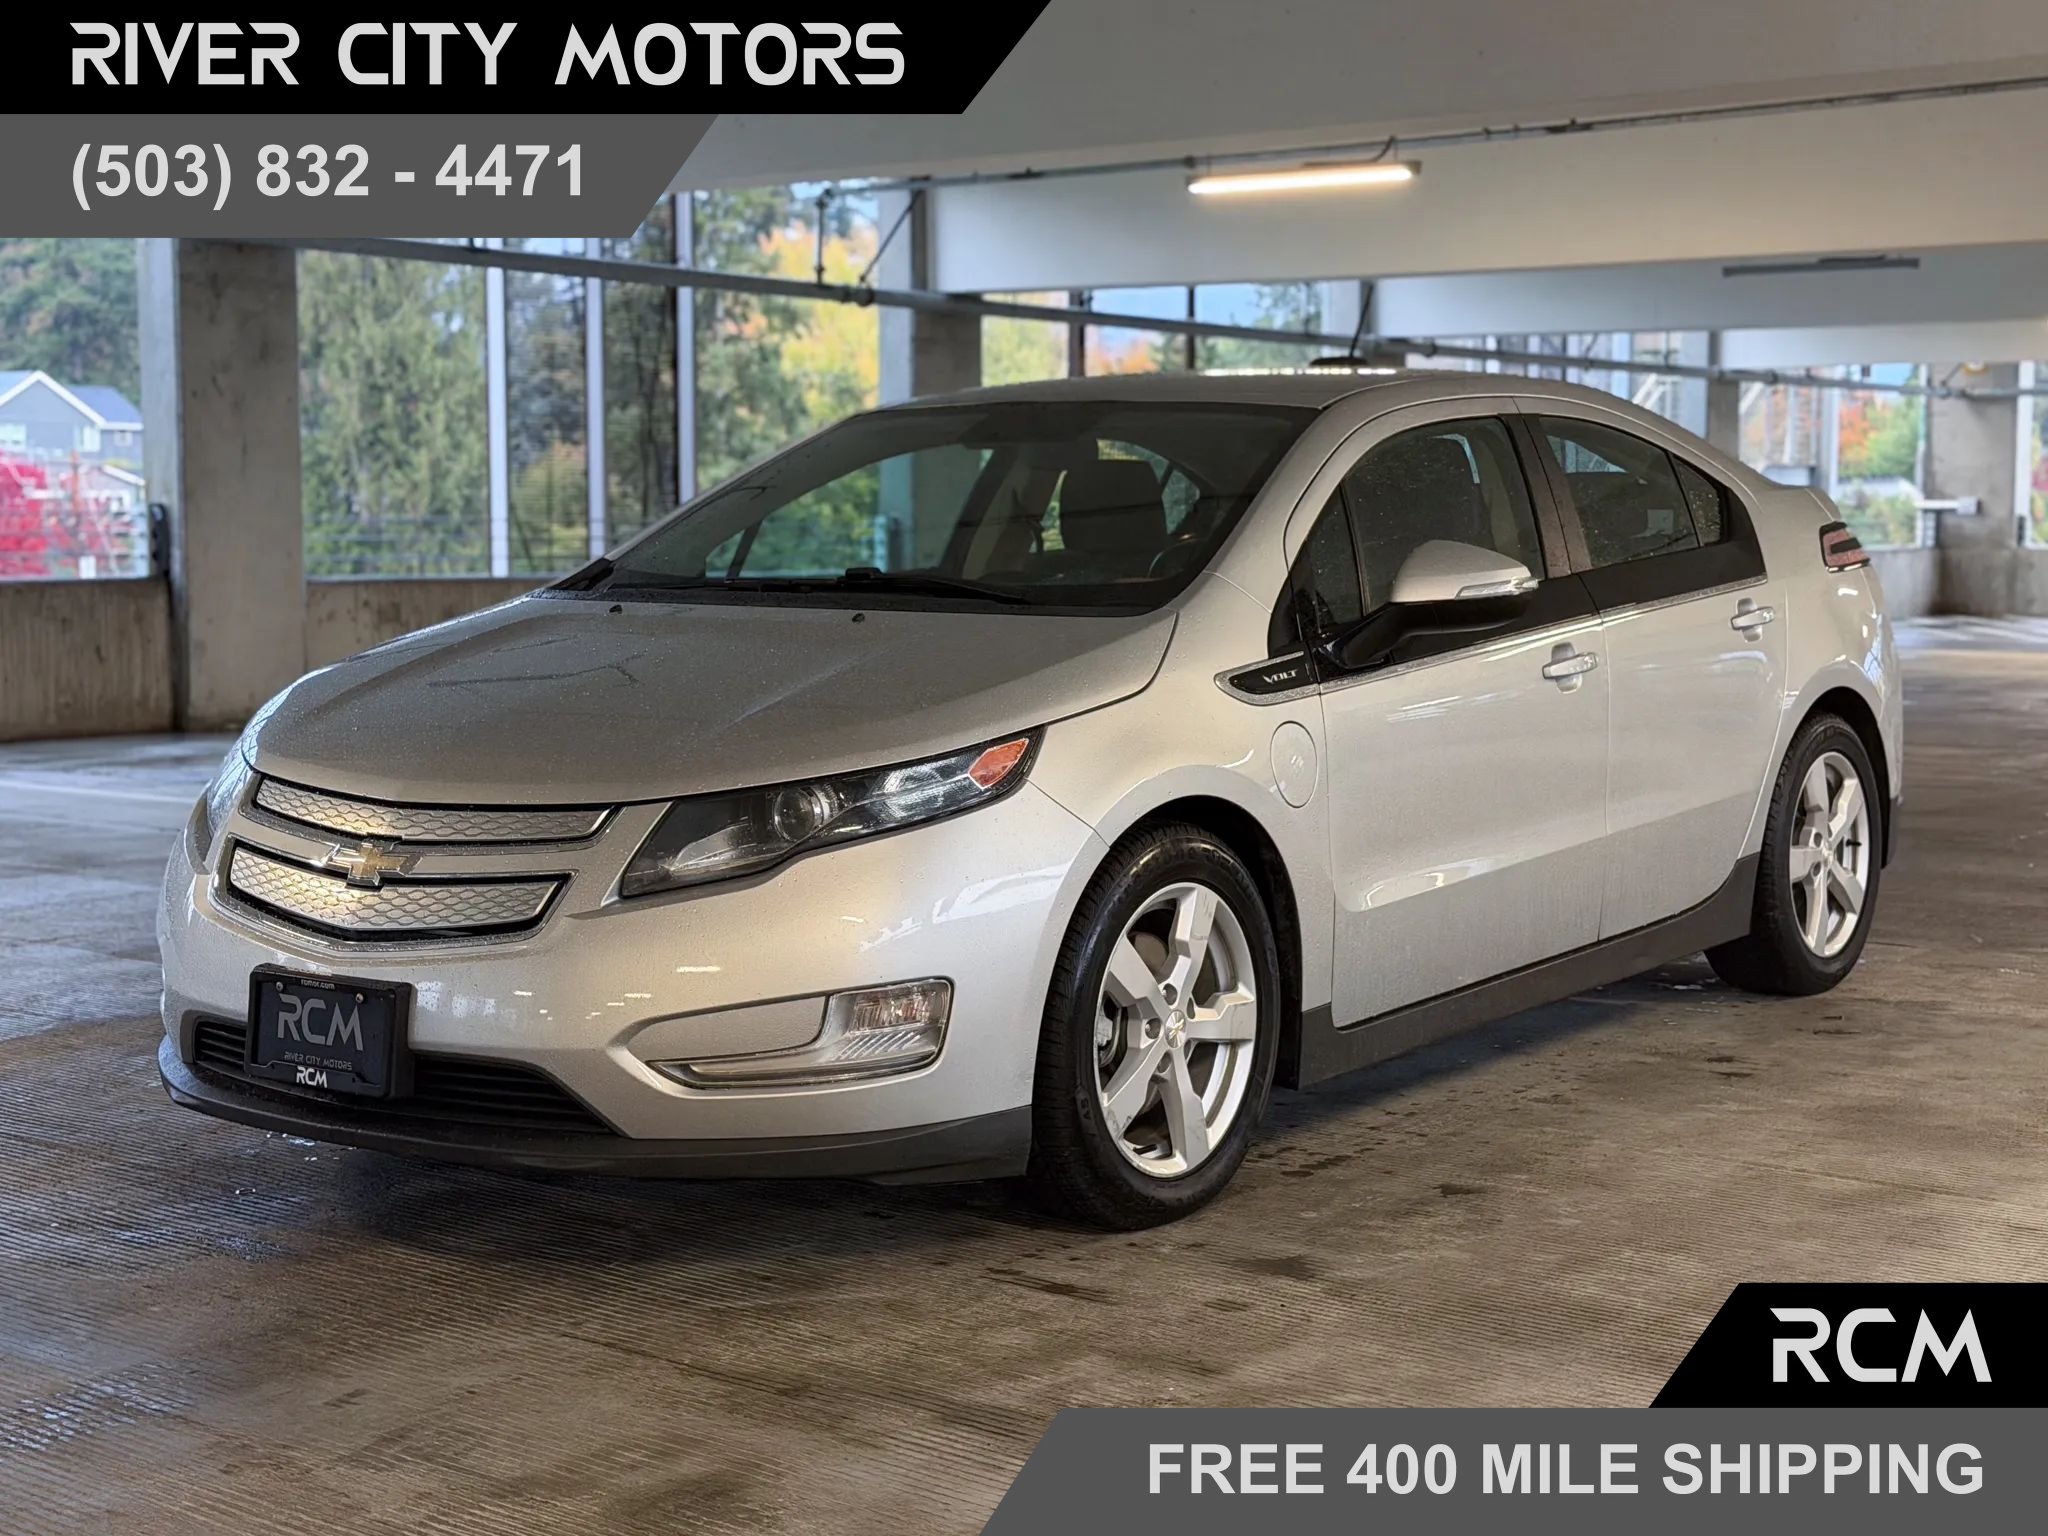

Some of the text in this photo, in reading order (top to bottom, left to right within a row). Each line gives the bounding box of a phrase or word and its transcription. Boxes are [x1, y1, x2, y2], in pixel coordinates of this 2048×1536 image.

[1262, 668, 1298, 684] VOLT
[277, 993, 364, 1052] RCM
[284, 1051, 353, 1071] RIVER CITY MOTORS
[295, 1065, 328, 1088] RCM
